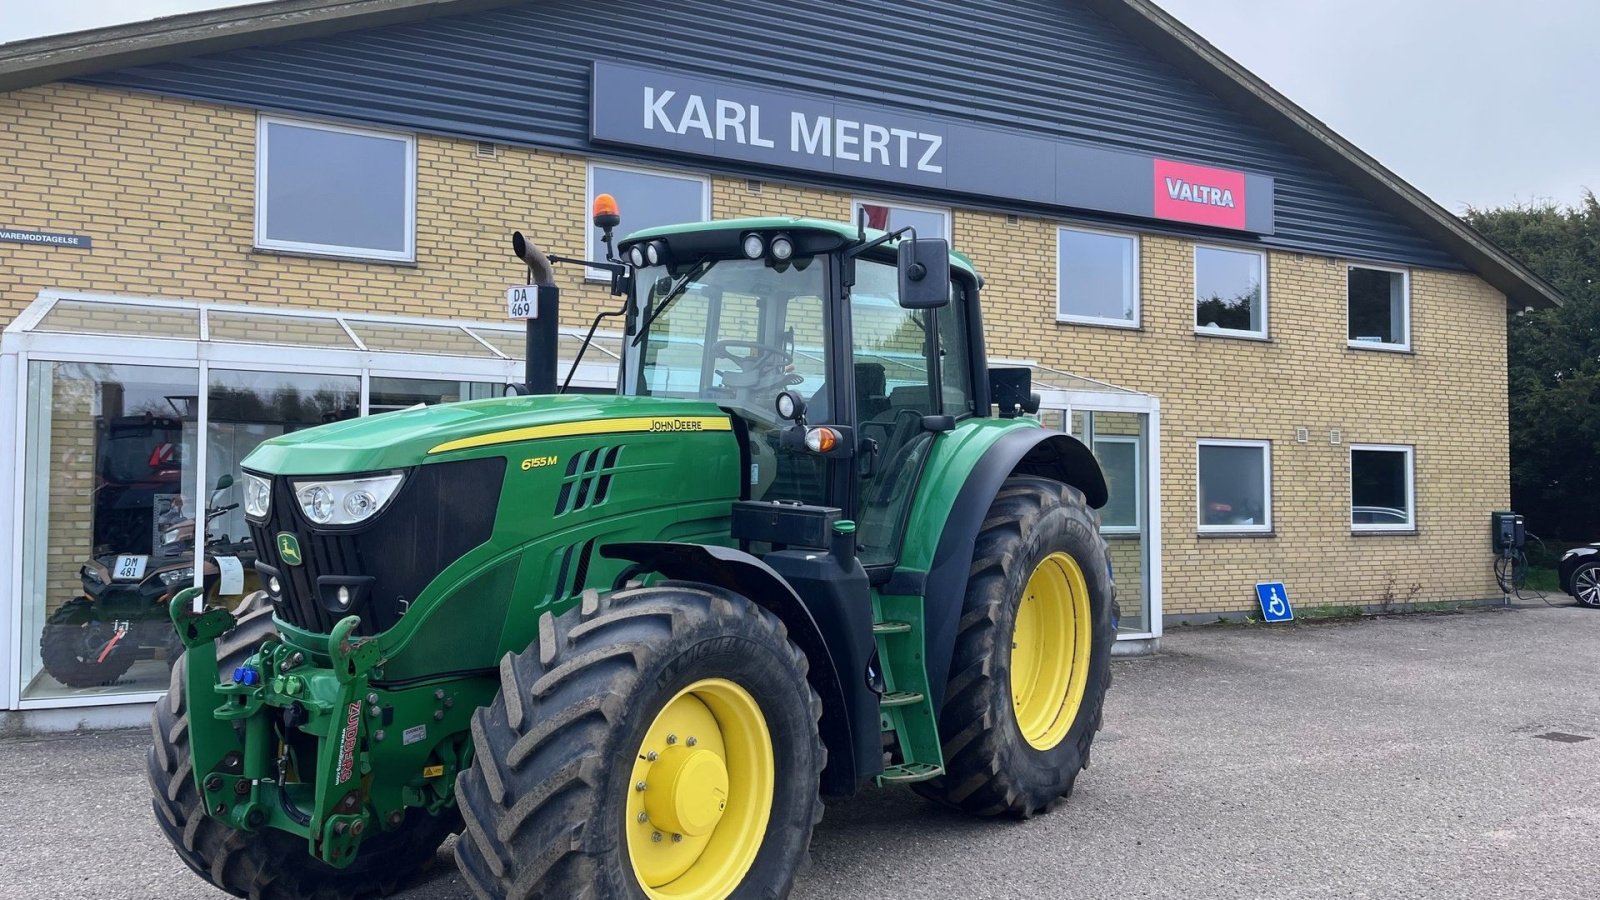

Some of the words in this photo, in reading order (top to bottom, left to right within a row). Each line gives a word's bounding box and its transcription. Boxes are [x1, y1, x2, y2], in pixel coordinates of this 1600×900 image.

[643, 86, 775, 149] KARL
[790, 111, 943, 174] MERTZ
[1165, 176, 1235, 208] VALTRA
[0, 231, 79, 245] VAREMODTAGELSE
[514, 288, 528, 302] DA
[511, 302, 530, 316] 469
[124, 557, 139, 567] DM
[119, 567, 137, 577] 481
